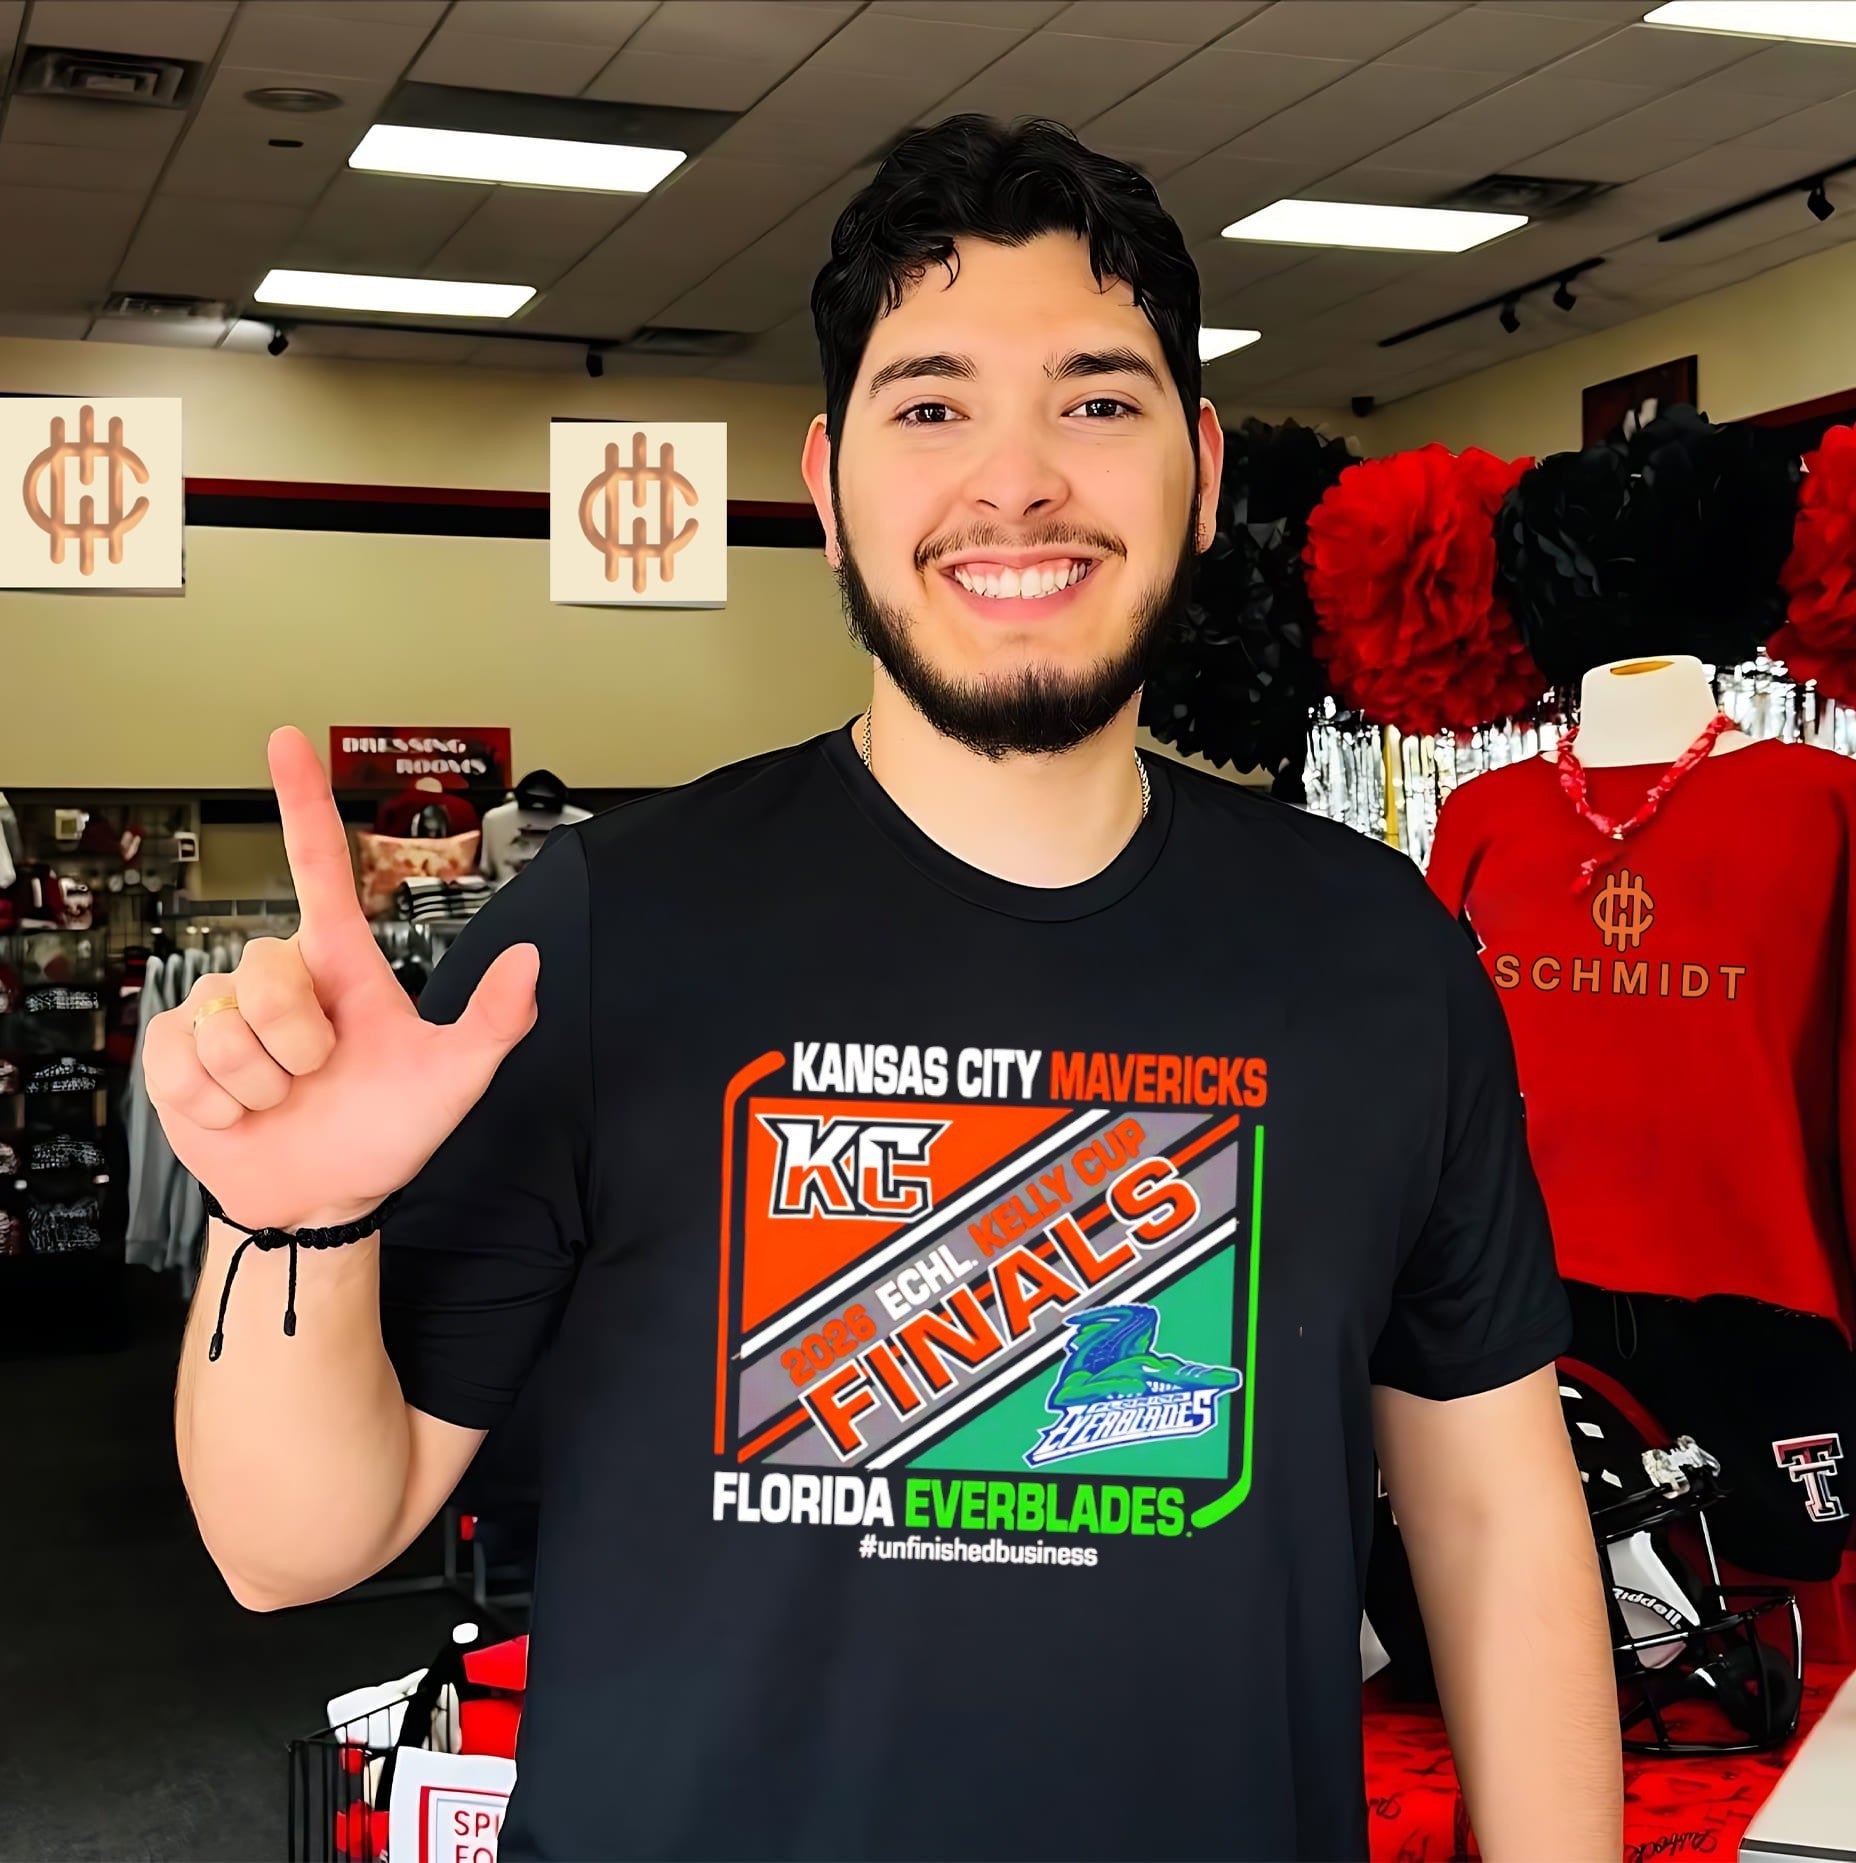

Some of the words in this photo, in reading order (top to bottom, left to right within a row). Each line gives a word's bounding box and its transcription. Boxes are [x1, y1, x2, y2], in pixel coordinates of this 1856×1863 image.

[342, 737, 467, 753] DRESSING
[396, 758, 487, 775] ROOMS
[1493, 953, 1747, 1001] SCHMIDT
[792, 1041, 949, 1097] KANSAS
[956, 1047, 1042, 1099] CITY
[1049, 1051, 1268, 1108] MAVERICKS
[755, 1114, 953, 1222] KC
[780, 1303, 877, 1389] 2026
[966, 1165, 1074, 1258] KELLY
[1069, 1117, 1148, 1187] CUP
[798, 1156, 1202, 1464] FINALS
[1038, 1388, 1221, 1462] EVERBLADES
[713, 1471, 895, 1526] FLORIDA
[859, 1534, 1099, 1567] #unfinishedbusiness
